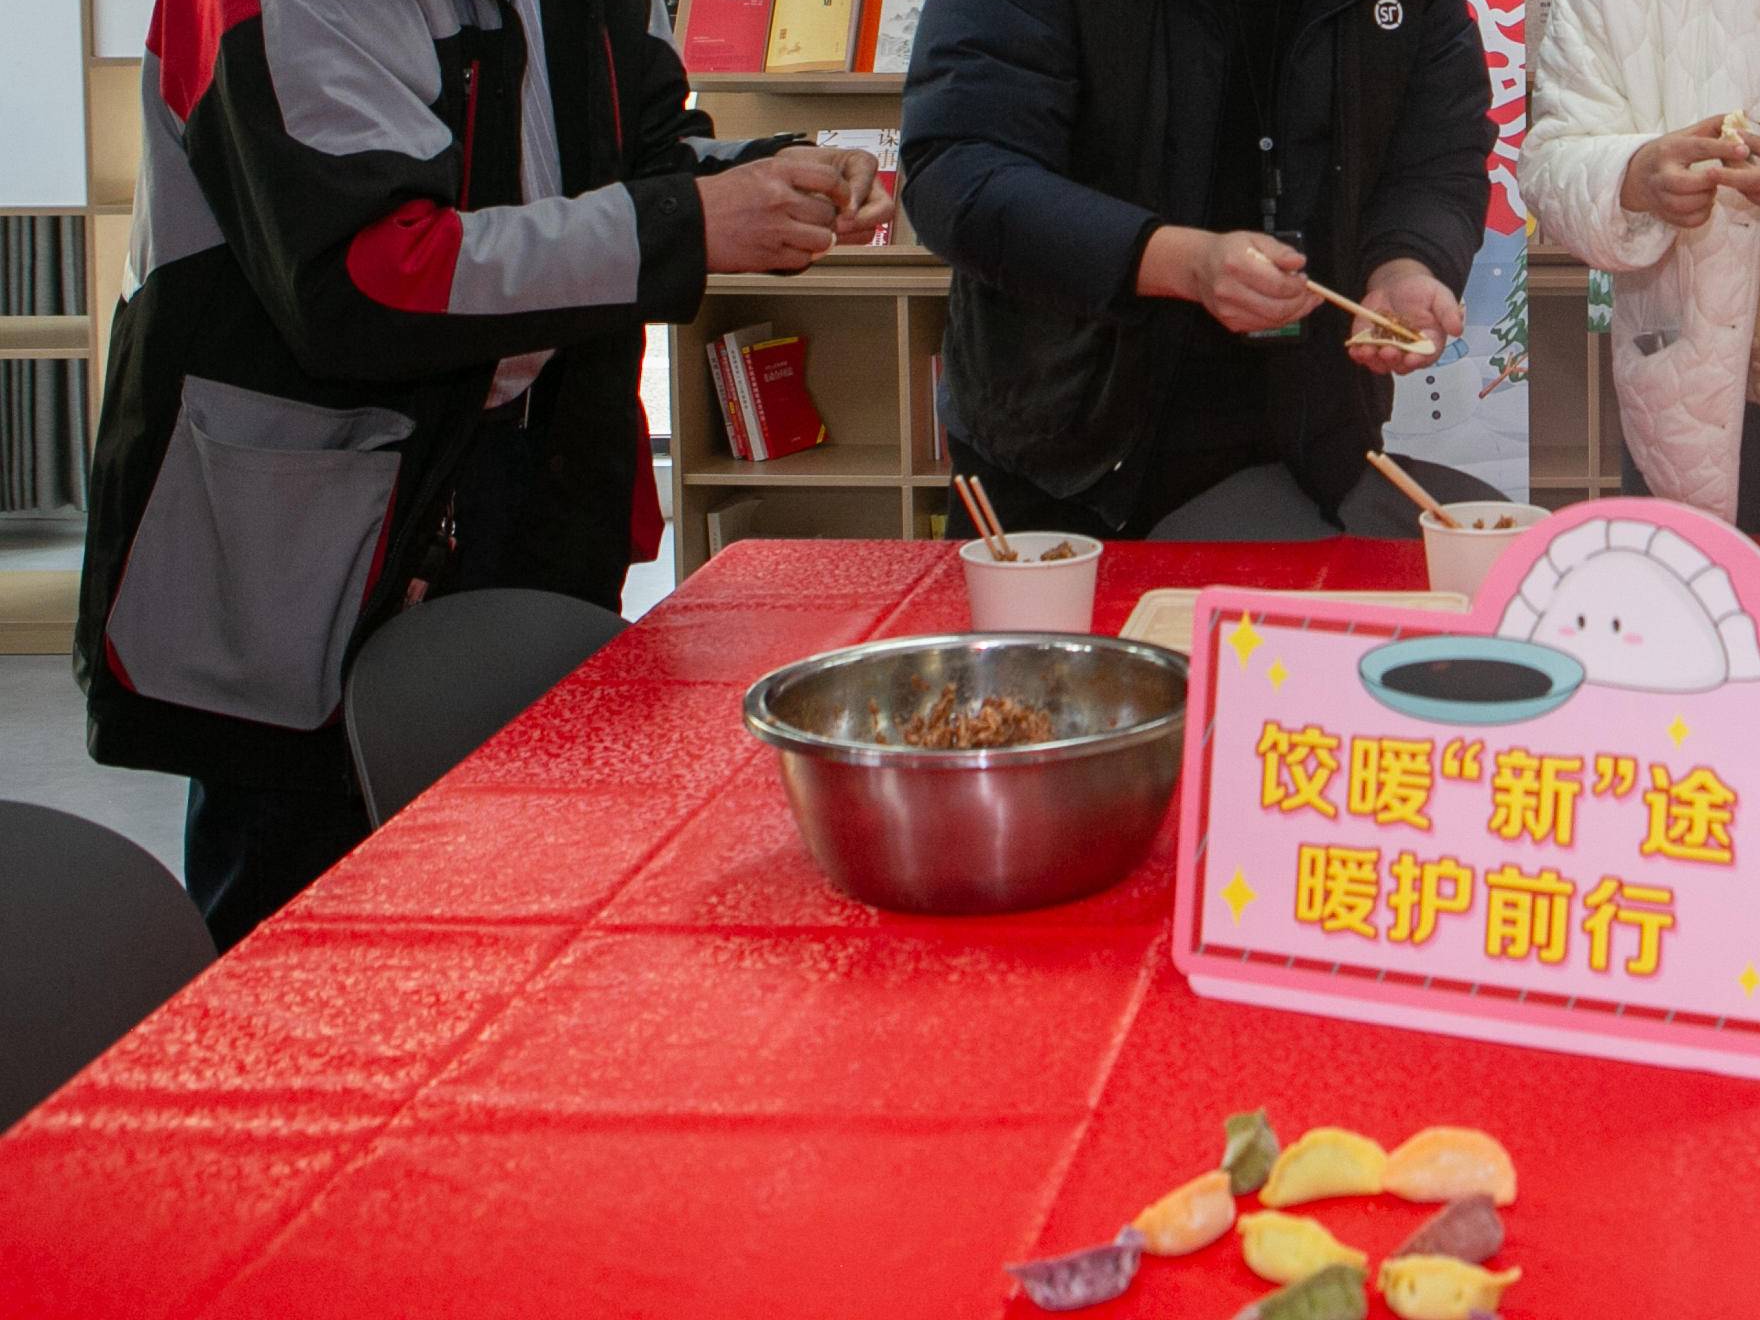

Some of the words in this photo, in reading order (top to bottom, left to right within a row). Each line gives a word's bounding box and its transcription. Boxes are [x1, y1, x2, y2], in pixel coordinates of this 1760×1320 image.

[1256, 721, 1738, 866] 饺暖“新”途
[1294, 843, 1676, 978] 暖护前行
